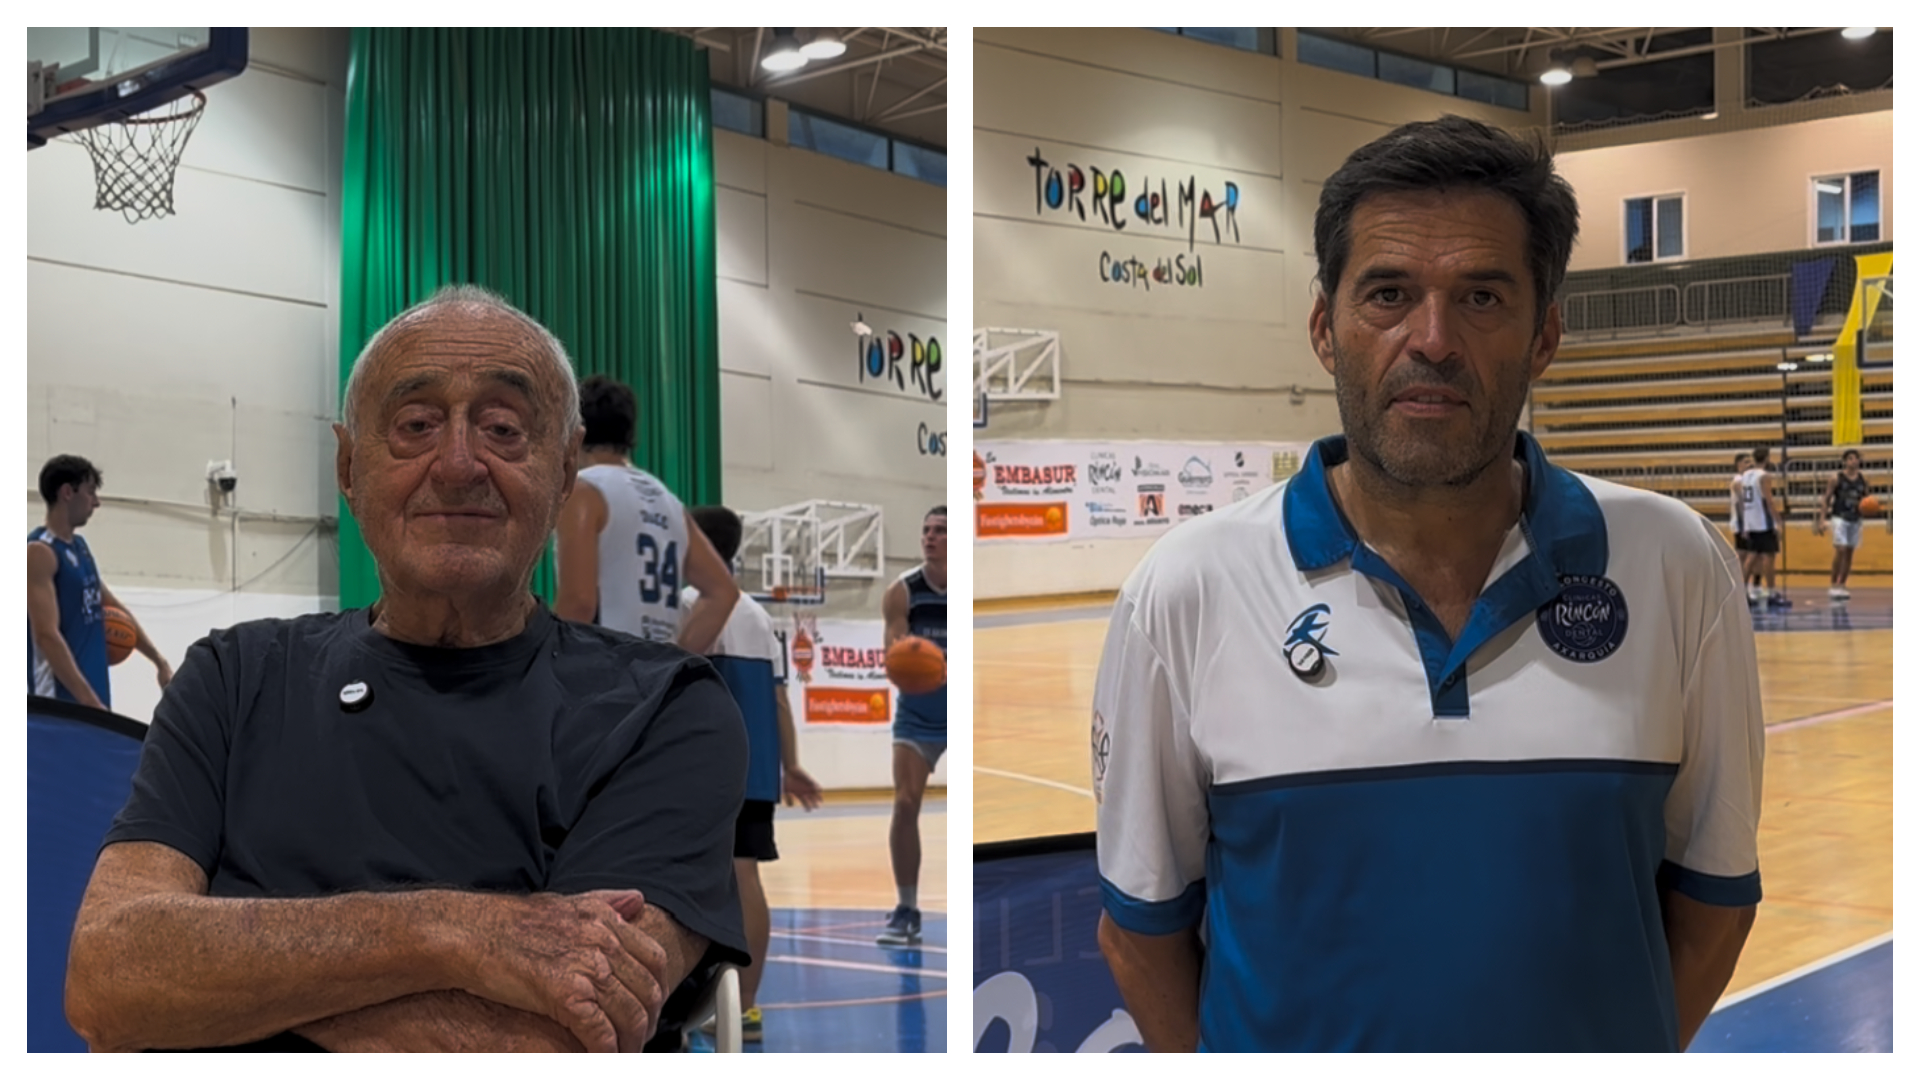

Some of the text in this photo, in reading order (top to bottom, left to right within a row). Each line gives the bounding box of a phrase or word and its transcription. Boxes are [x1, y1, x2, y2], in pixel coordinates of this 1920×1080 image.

[1134, 176, 1168, 226] del
[1178, 175, 1240, 253] MAR
[1100, 251, 1202, 291] Costa del Sol
[917, 422, 947, 457] Cos
[994, 465, 1077, 485] EMBASUR
[636, 532, 679, 610] 34
[821, 646, 887, 668] EMBASU
